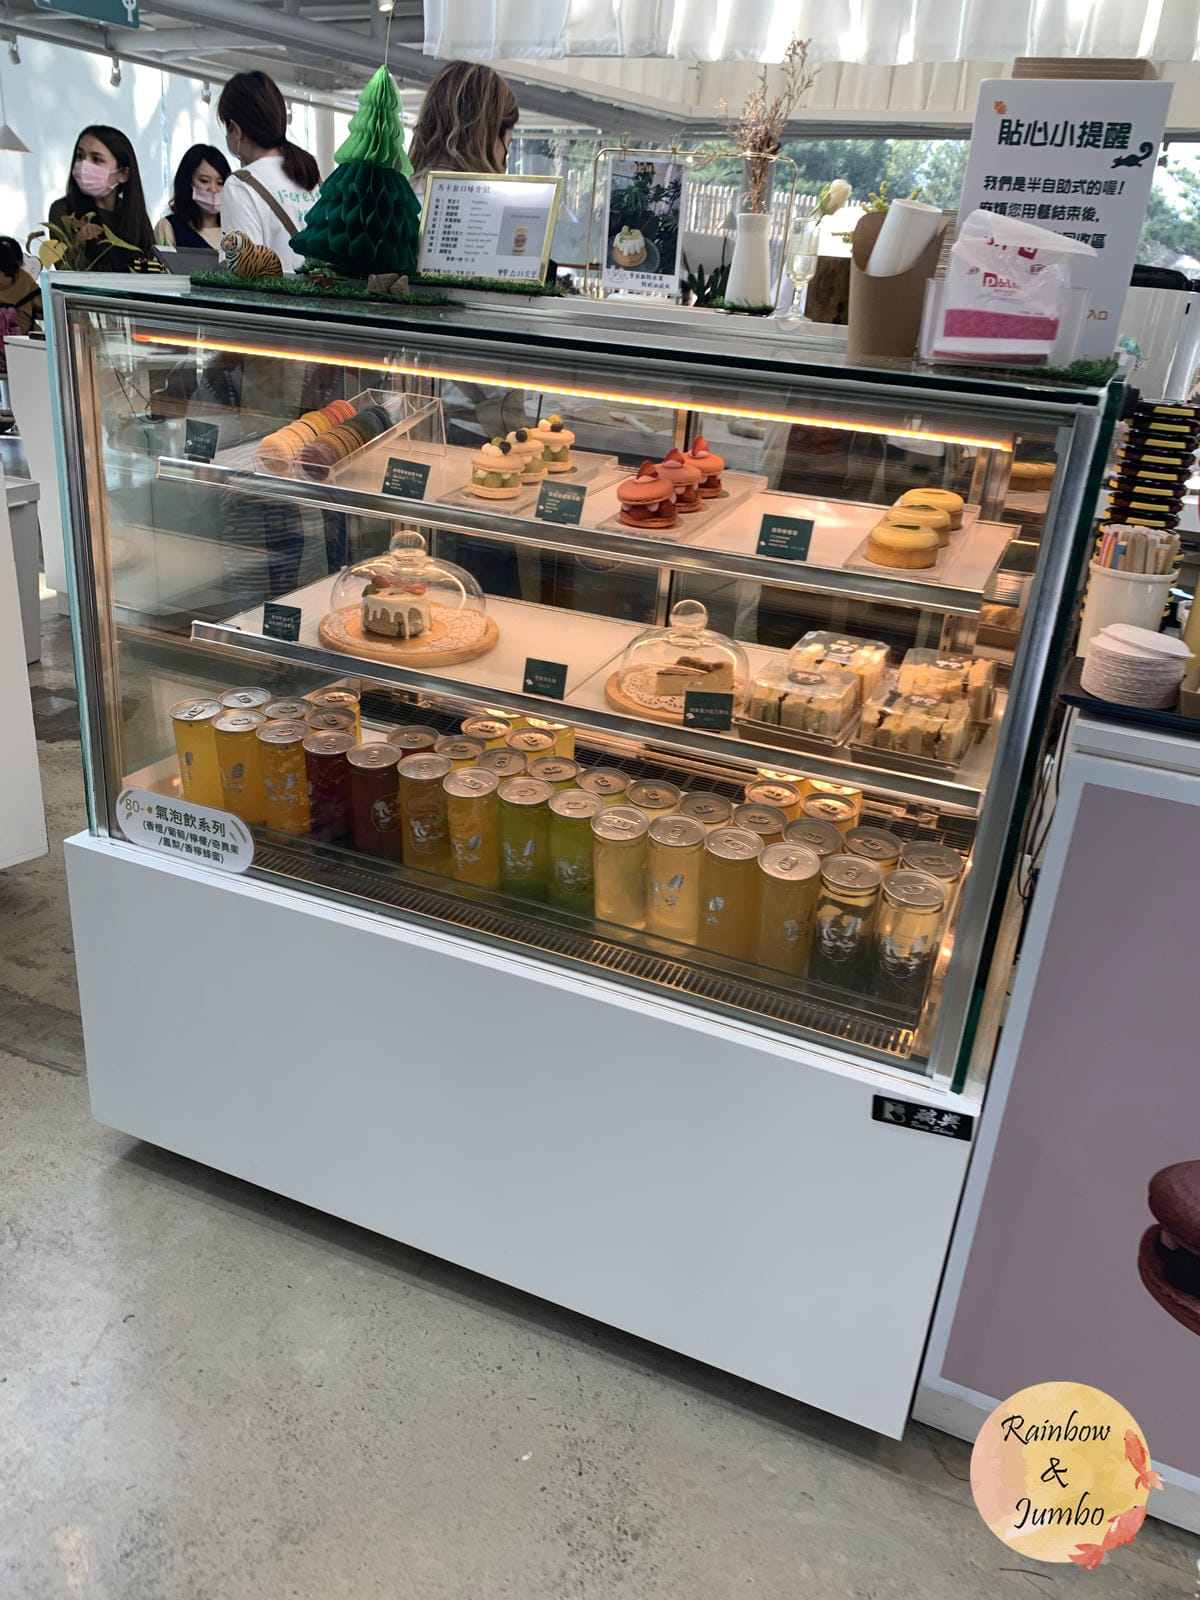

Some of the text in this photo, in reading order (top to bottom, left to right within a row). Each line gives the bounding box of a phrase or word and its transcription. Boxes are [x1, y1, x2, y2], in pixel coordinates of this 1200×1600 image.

[997, 119, 1132, 150] 貼心小提醒
[155, 804, 226, 837] 氣泡飲系列
